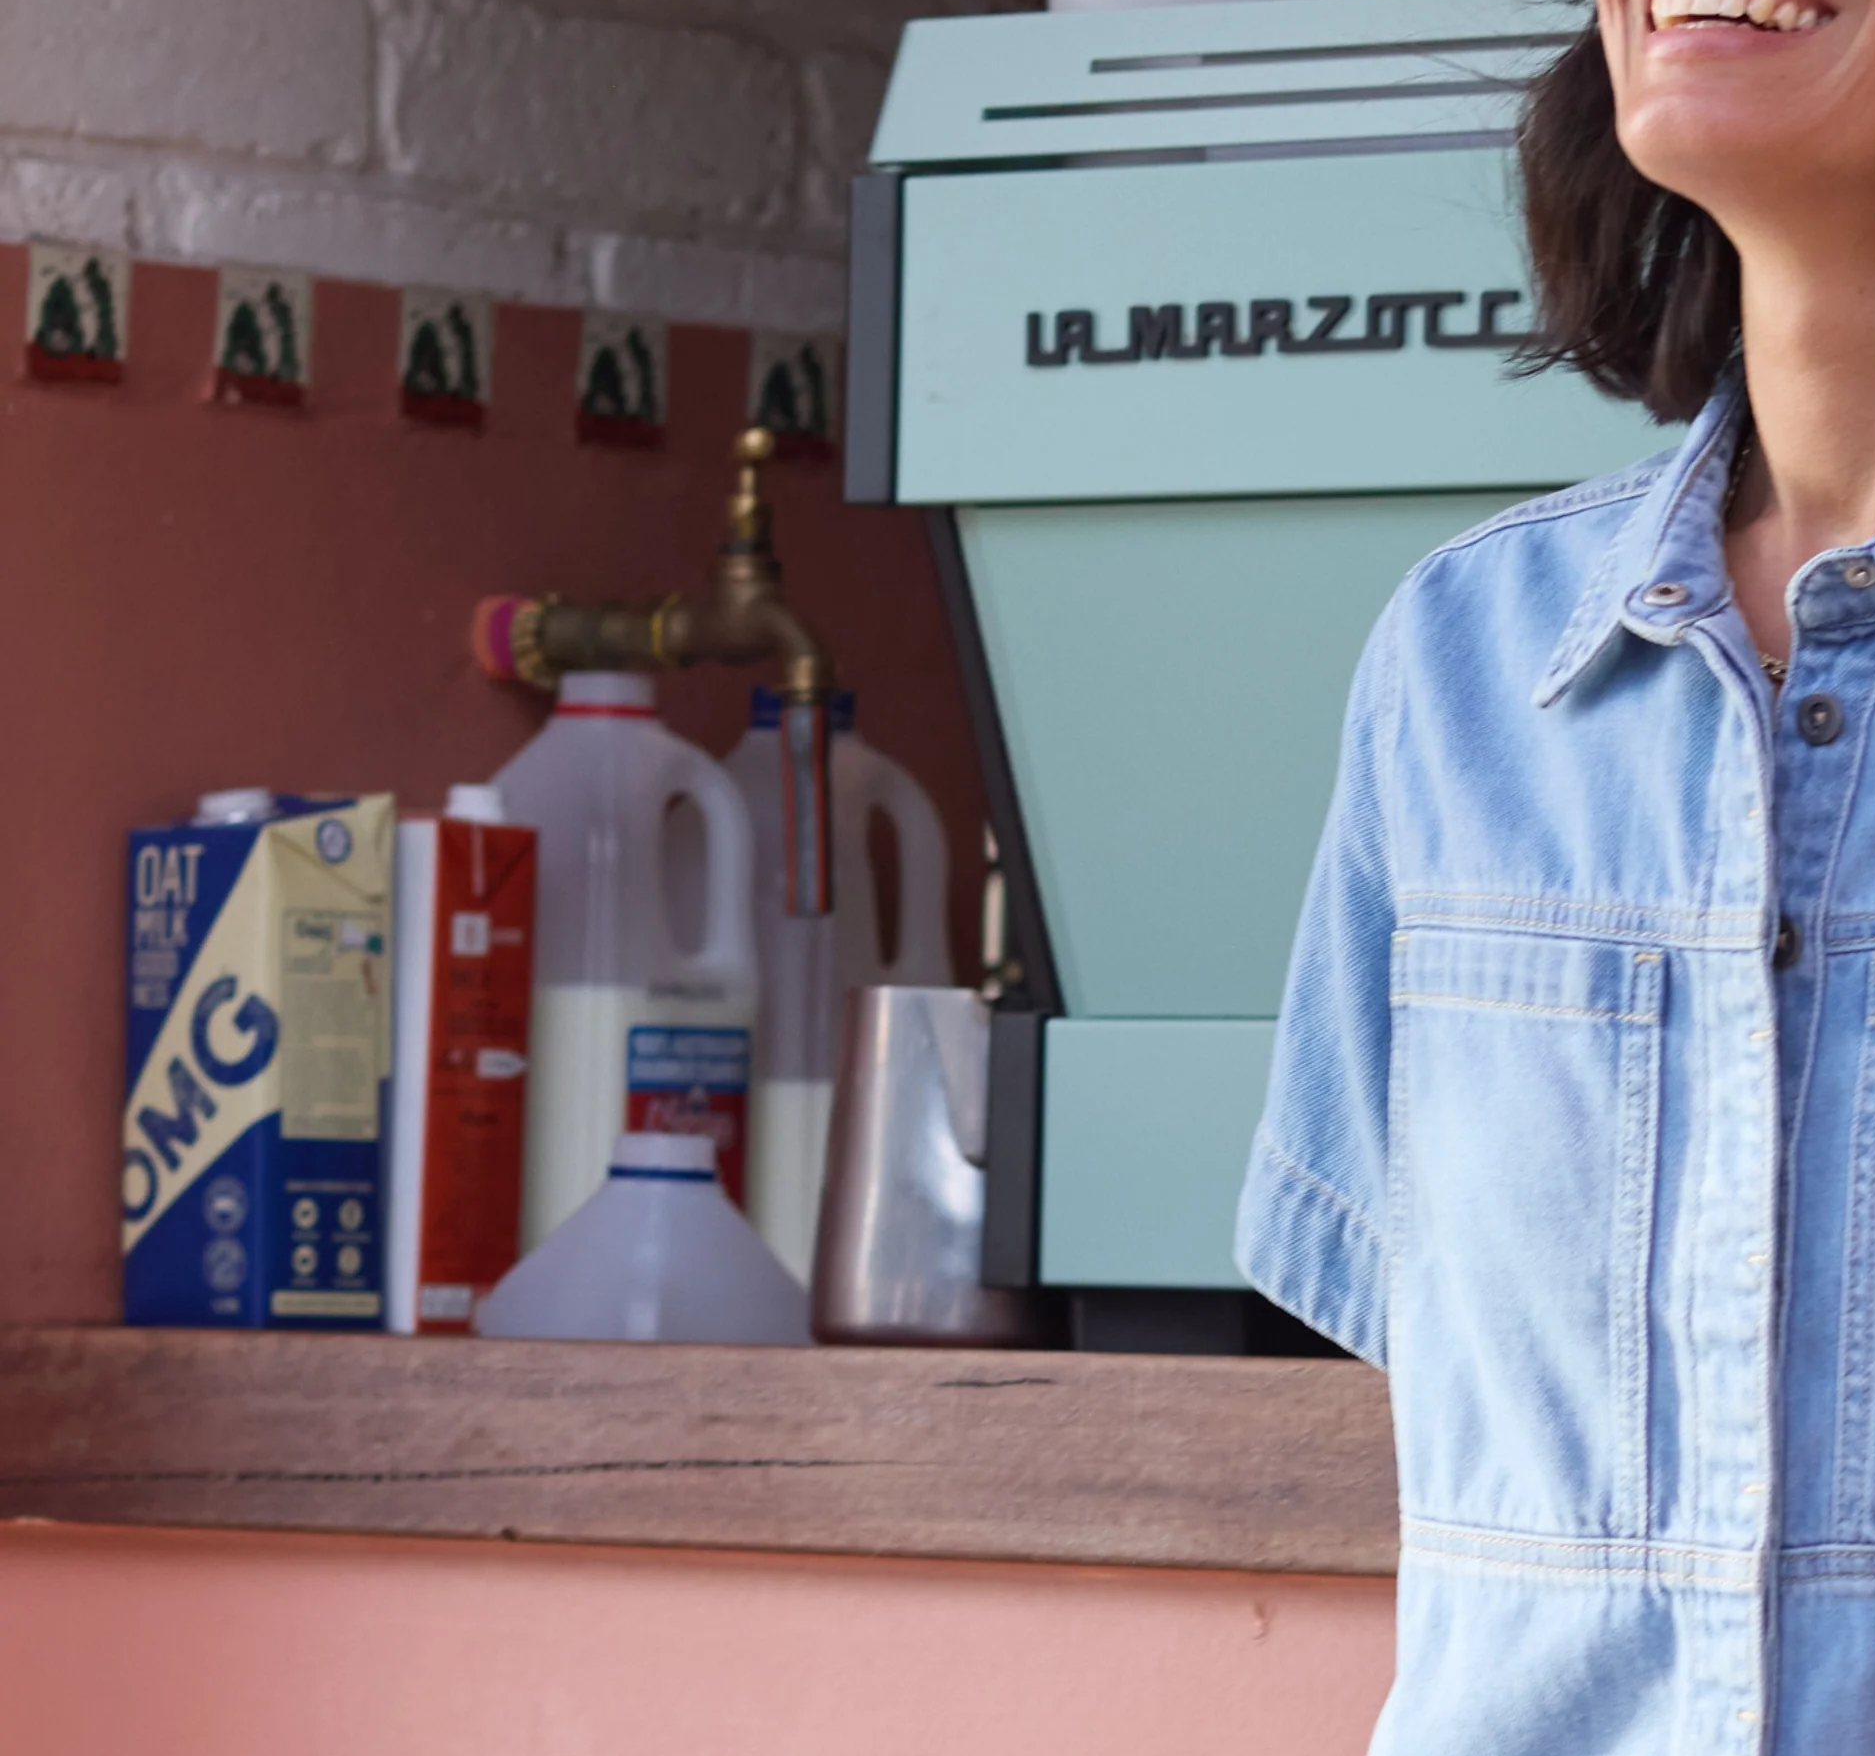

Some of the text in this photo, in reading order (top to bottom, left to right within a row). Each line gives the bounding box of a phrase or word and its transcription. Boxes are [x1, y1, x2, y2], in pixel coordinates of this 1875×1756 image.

[1026, 289, 1542, 367] LA MARZOCC
[136, 843, 204, 906] OAT
[134, 908, 189, 951] MILK
[124, 975, 280, 1221] OMG
